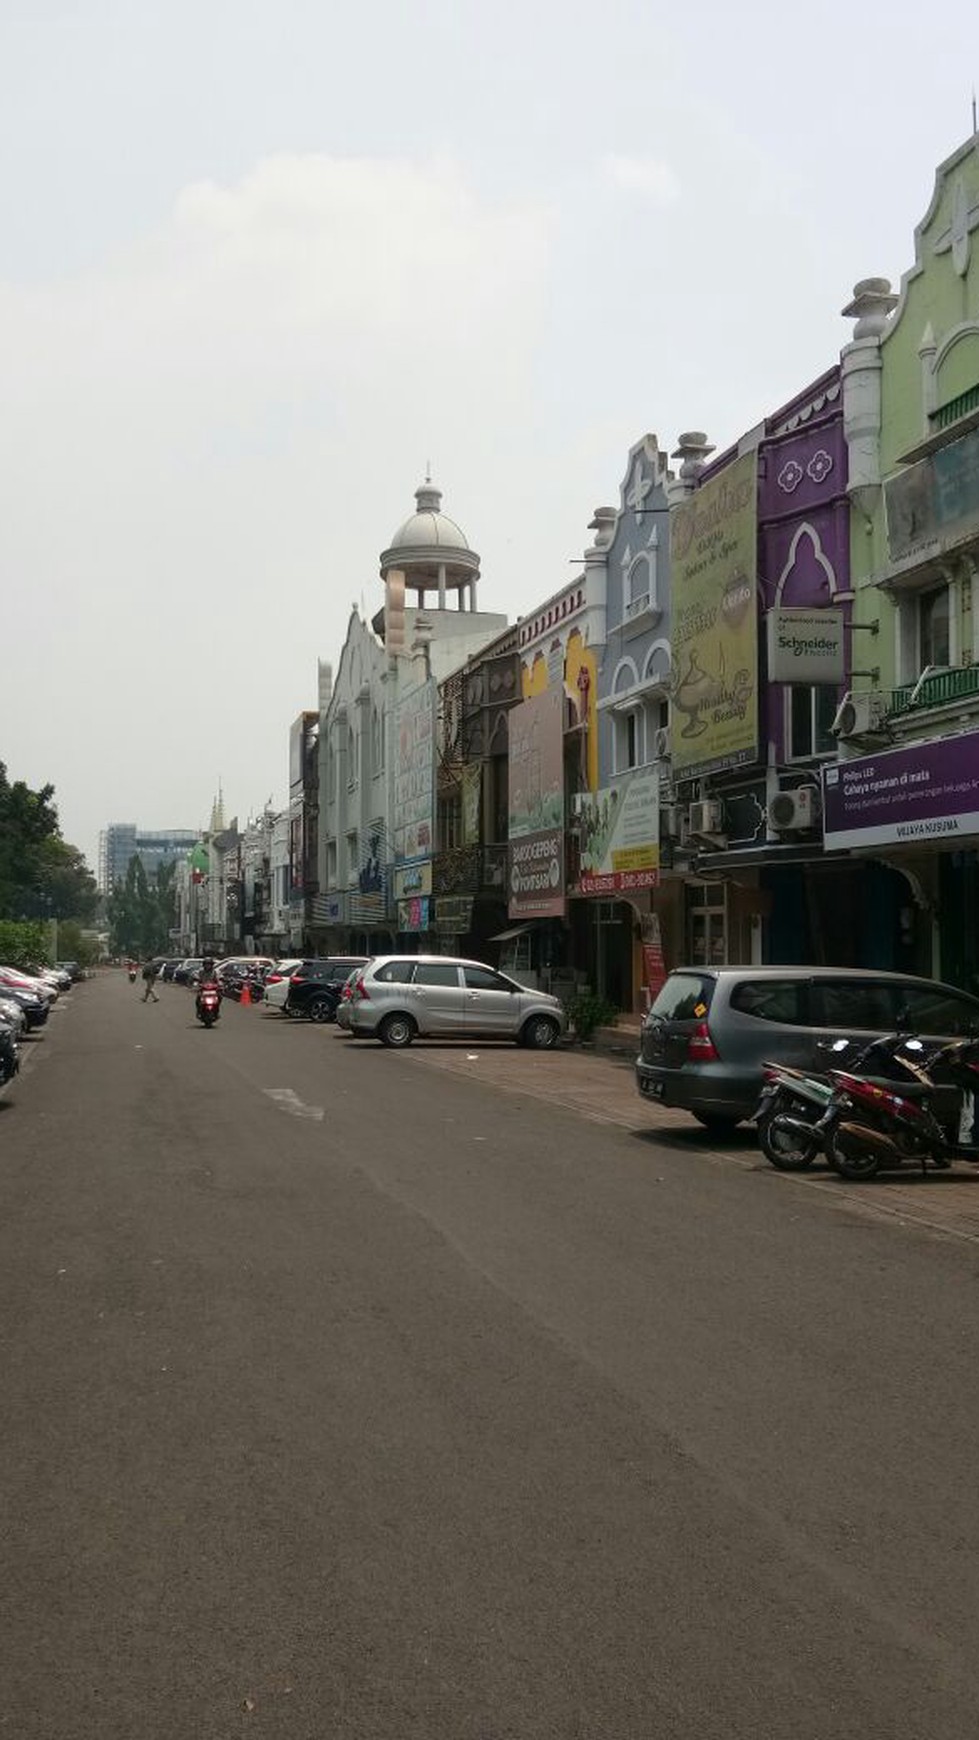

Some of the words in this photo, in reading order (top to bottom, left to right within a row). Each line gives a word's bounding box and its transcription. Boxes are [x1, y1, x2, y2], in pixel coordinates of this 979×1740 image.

[778, 636, 839, 656] Schneider
[843, 783, 869, 797] Cahaya
[900, 772, 908, 785] di
[908, 769, 930, 783] mata
[924, 818, 959, 835] KUSUMA
